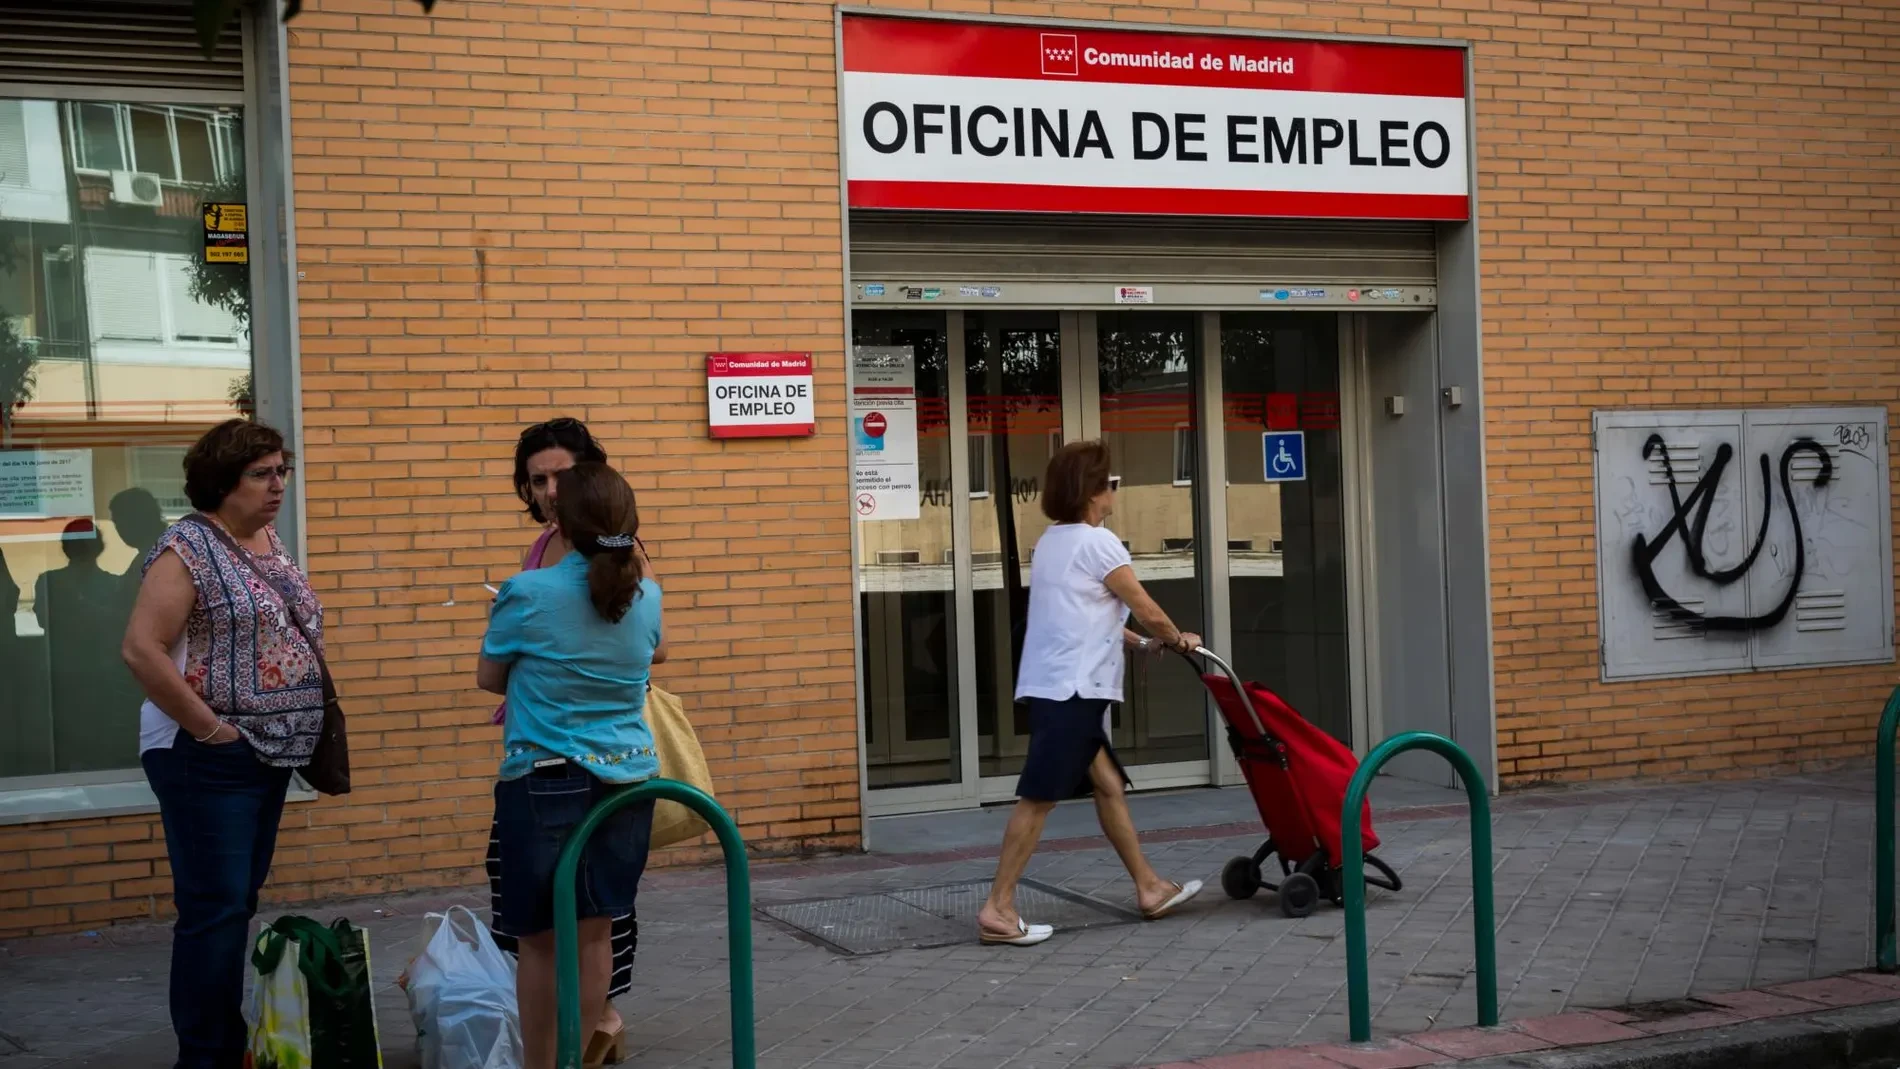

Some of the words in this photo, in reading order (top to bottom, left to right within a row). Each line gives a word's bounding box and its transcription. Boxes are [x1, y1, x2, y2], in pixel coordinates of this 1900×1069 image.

[1084, 48, 1194, 69] Comunidad
[1200, 54, 1223, 71] de
[1229, 55, 1294, 74] Madrid
[863, 101, 1114, 159] OFICINA
[1132, 112, 1208, 161] DE
[1227, 115, 1450, 168] EMPLEO
[715, 385, 781, 400] OFICINA
[786, 384, 807, 398] DE
[729, 402, 796, 416] EMPLEO
